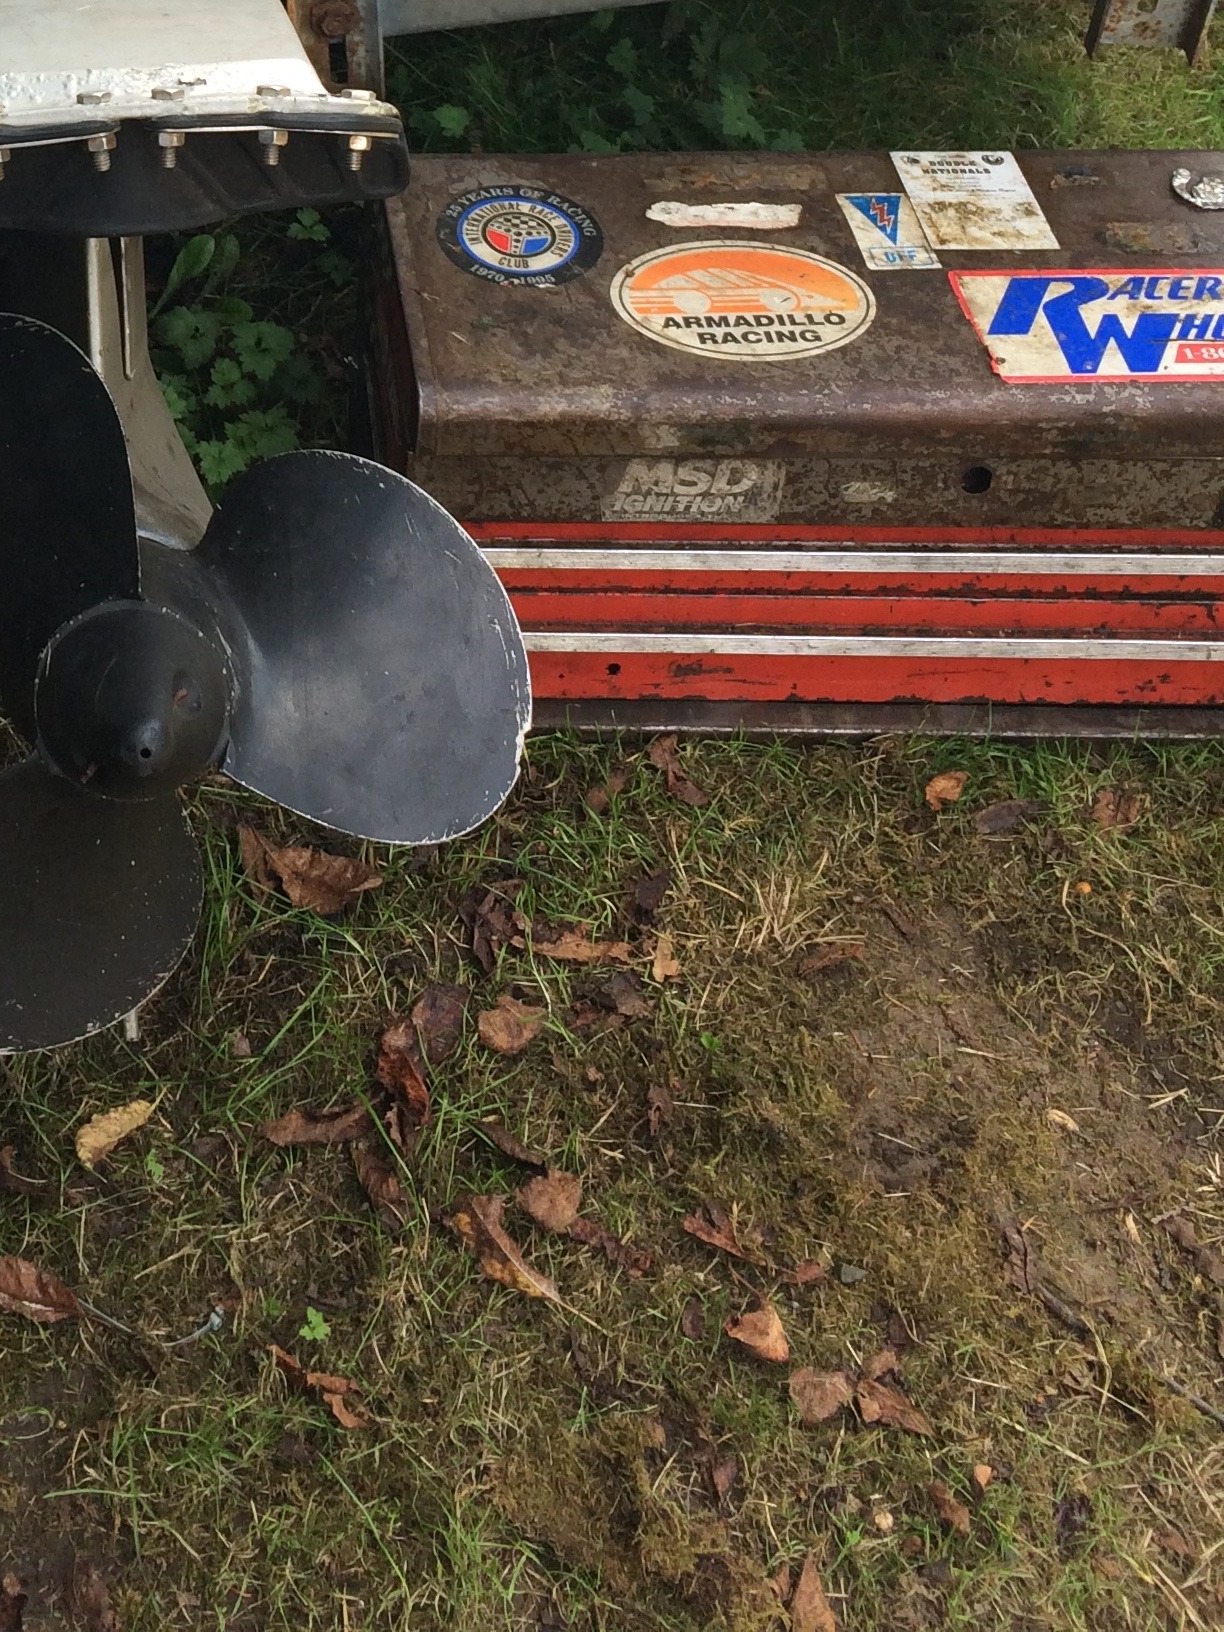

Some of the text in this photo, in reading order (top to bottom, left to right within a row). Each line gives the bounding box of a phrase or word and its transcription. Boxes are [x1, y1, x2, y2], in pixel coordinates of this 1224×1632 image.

[444, 186, 597, 237] 25 YEARS OF RACING
[464, 201, 574, 259] INTERNATIONAL RACE DRIVERS
[497, 256, 530, 269] CLUB
[661, 311, 847, 330] ARMADILLO
[697, 329, 824, 346] RACING
[618, 458, 760, 495] MSD
[611, 494, 746, 514] IGNITION
